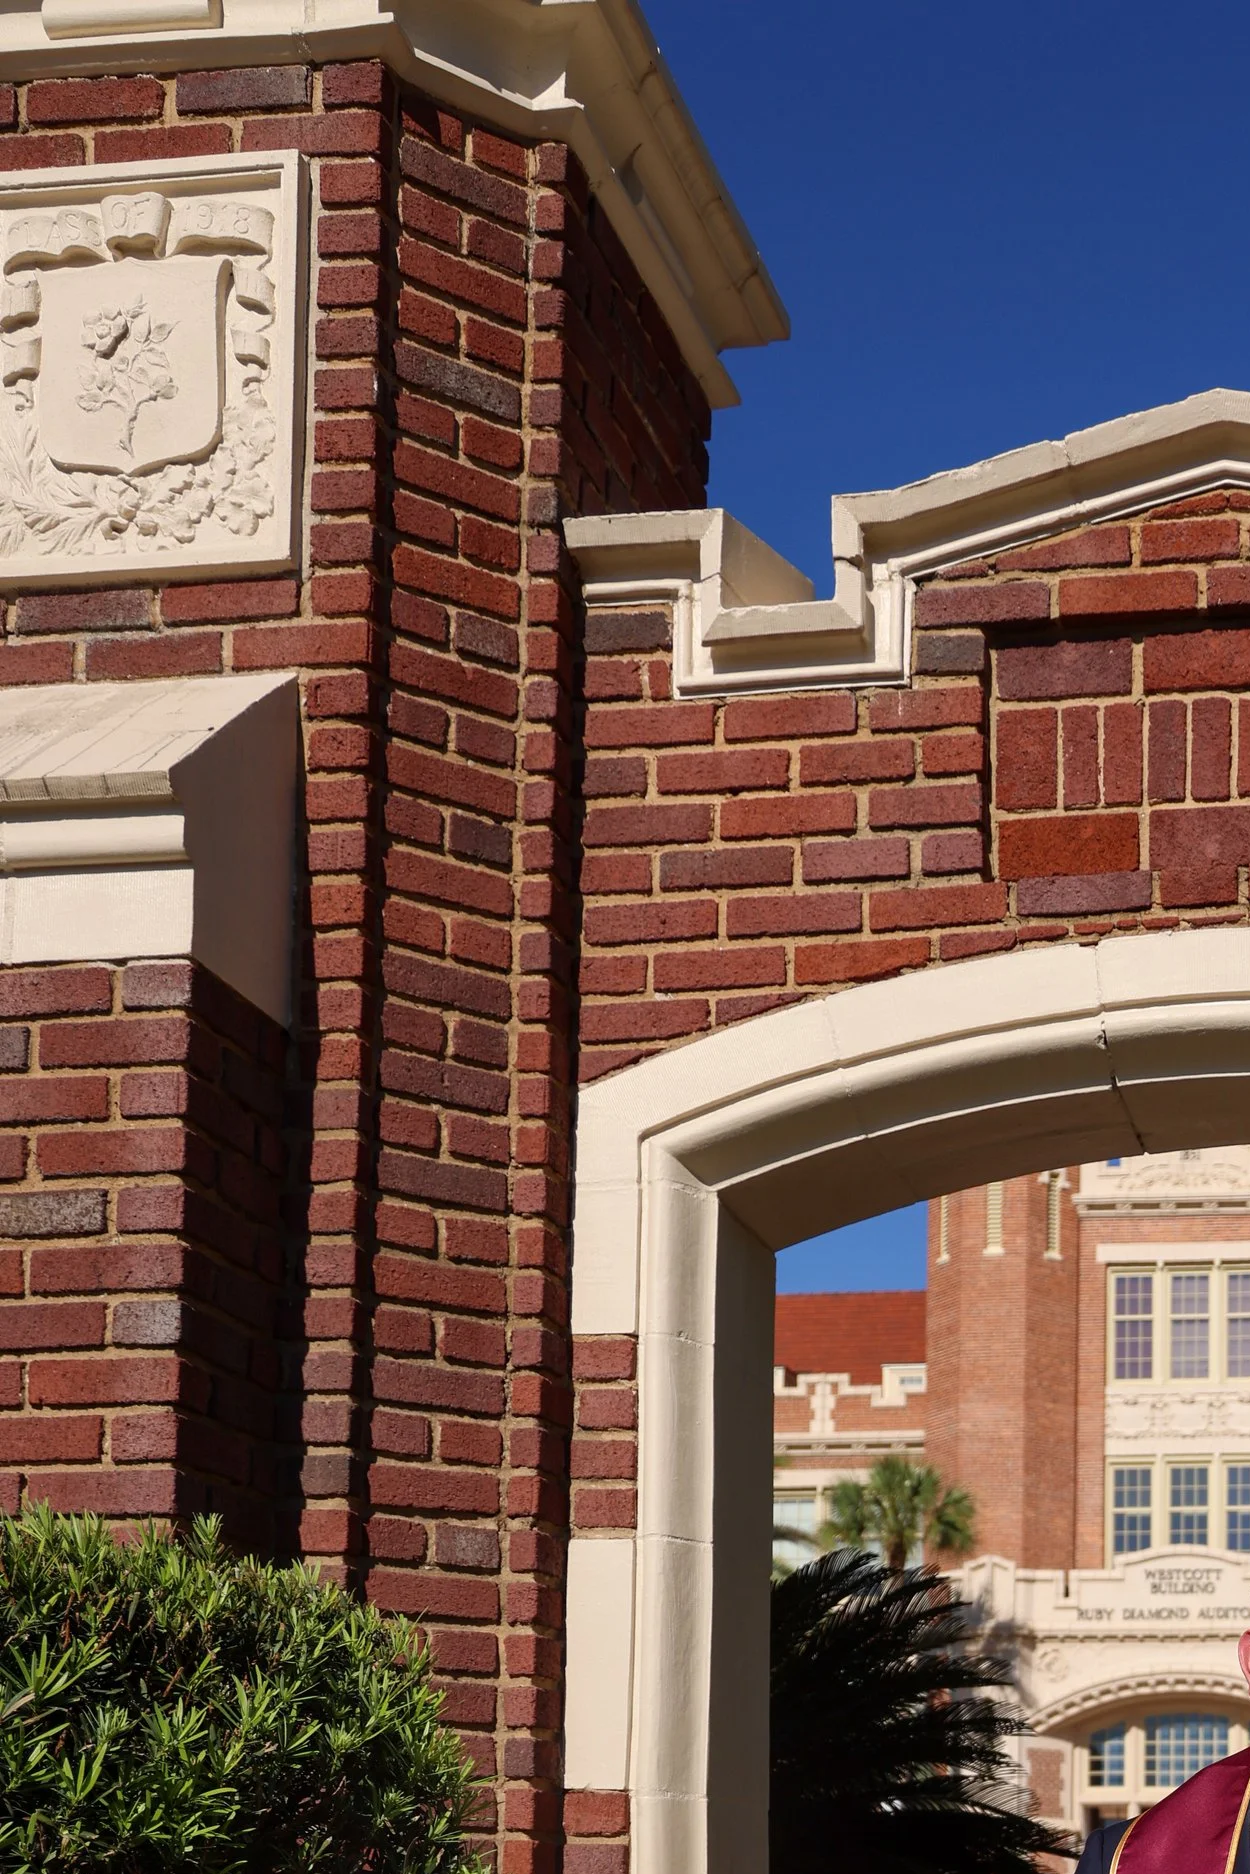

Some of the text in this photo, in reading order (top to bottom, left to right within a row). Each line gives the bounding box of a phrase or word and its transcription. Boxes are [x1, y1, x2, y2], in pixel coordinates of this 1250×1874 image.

[110, 198, 152, 230] OF
[181, 203, 251, 235] 1918
[1144, 1568, 1223, 1580] WESTCOTT
[1150, 1582, 1215, 1594] BUILDING
[1077, 1608, 1114, 1620] RUBY
[1123, 1607, 1189, 1620] DIAMOND
